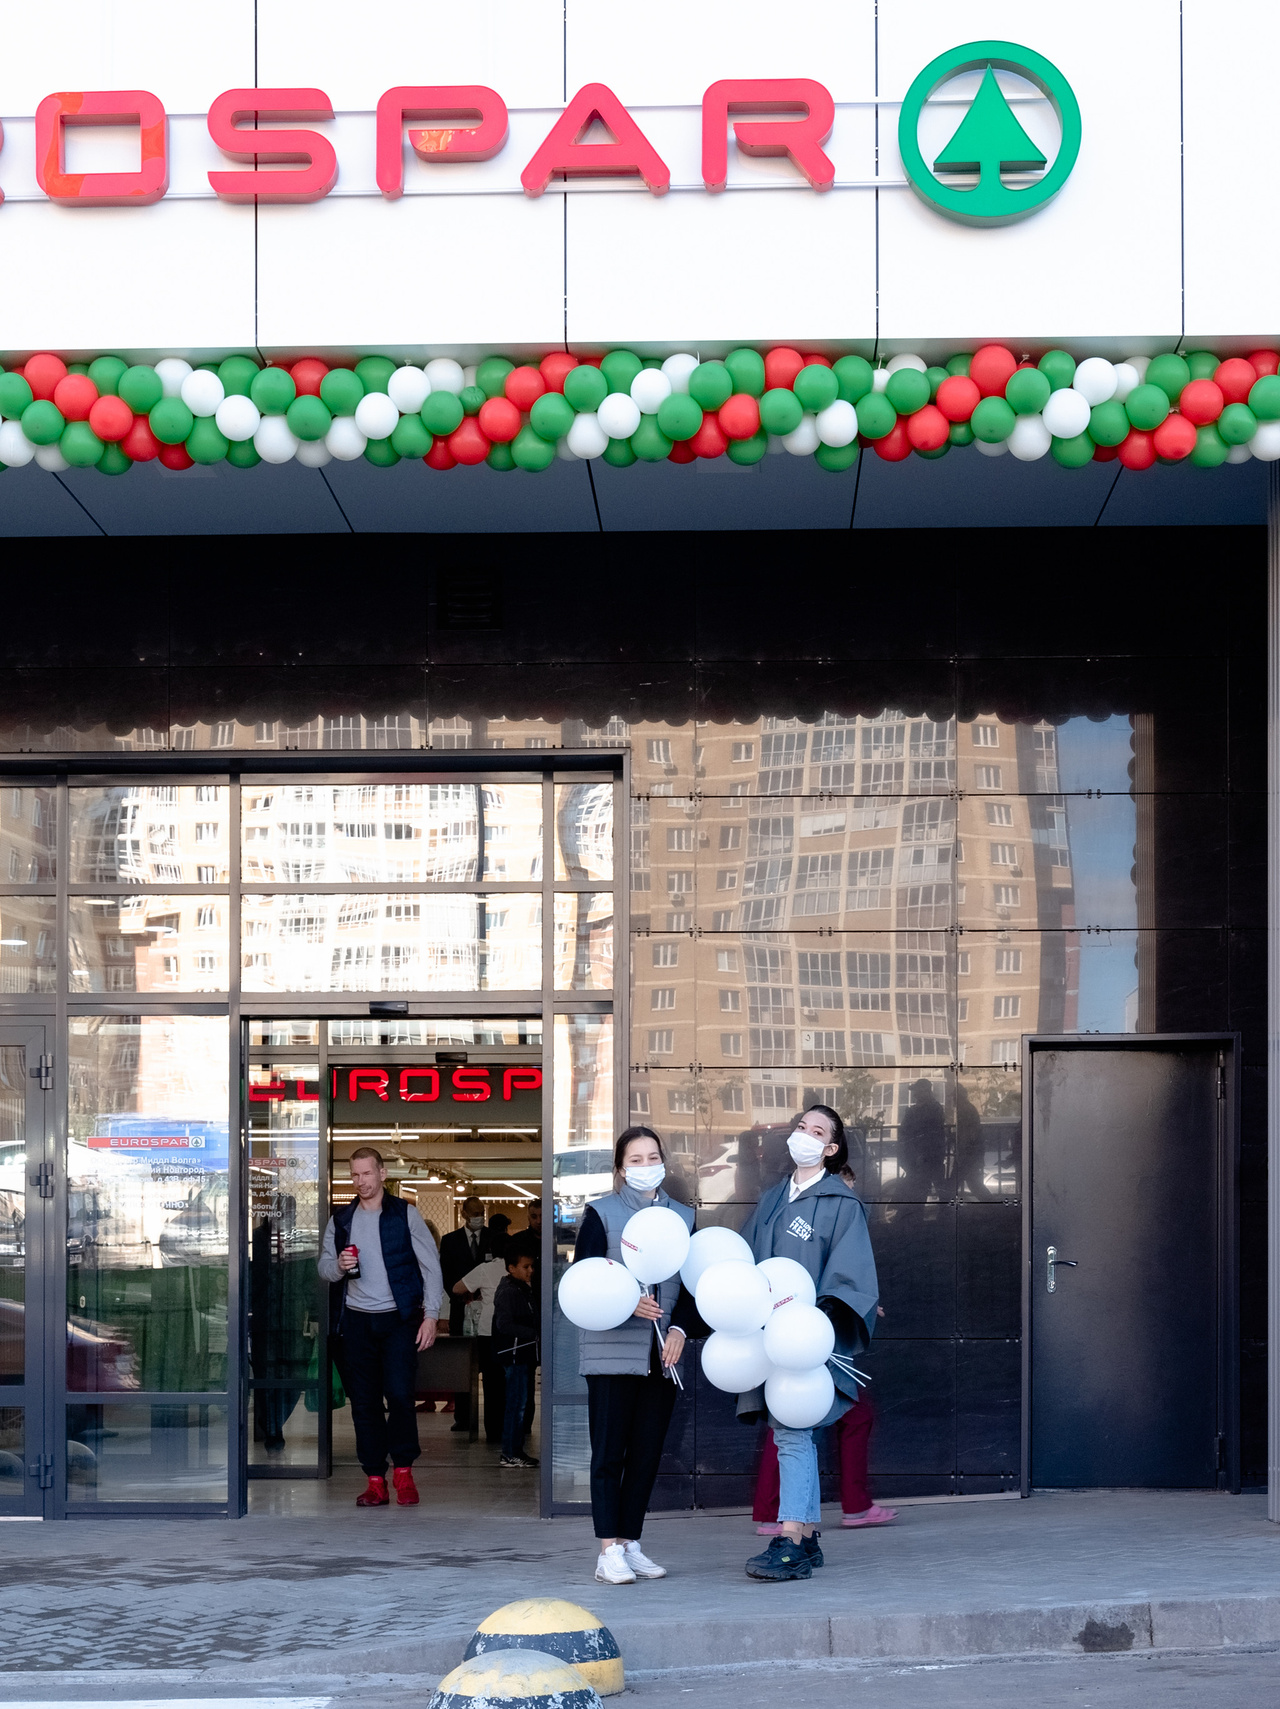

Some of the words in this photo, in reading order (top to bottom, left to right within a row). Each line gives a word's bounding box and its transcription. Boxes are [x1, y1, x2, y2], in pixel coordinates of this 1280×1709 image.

[110, 1138, 189, 1146] EUROSPAR
[163, 1166, 205, 1175] Новгород
[788, 1219, 811, 1242] FRESH
